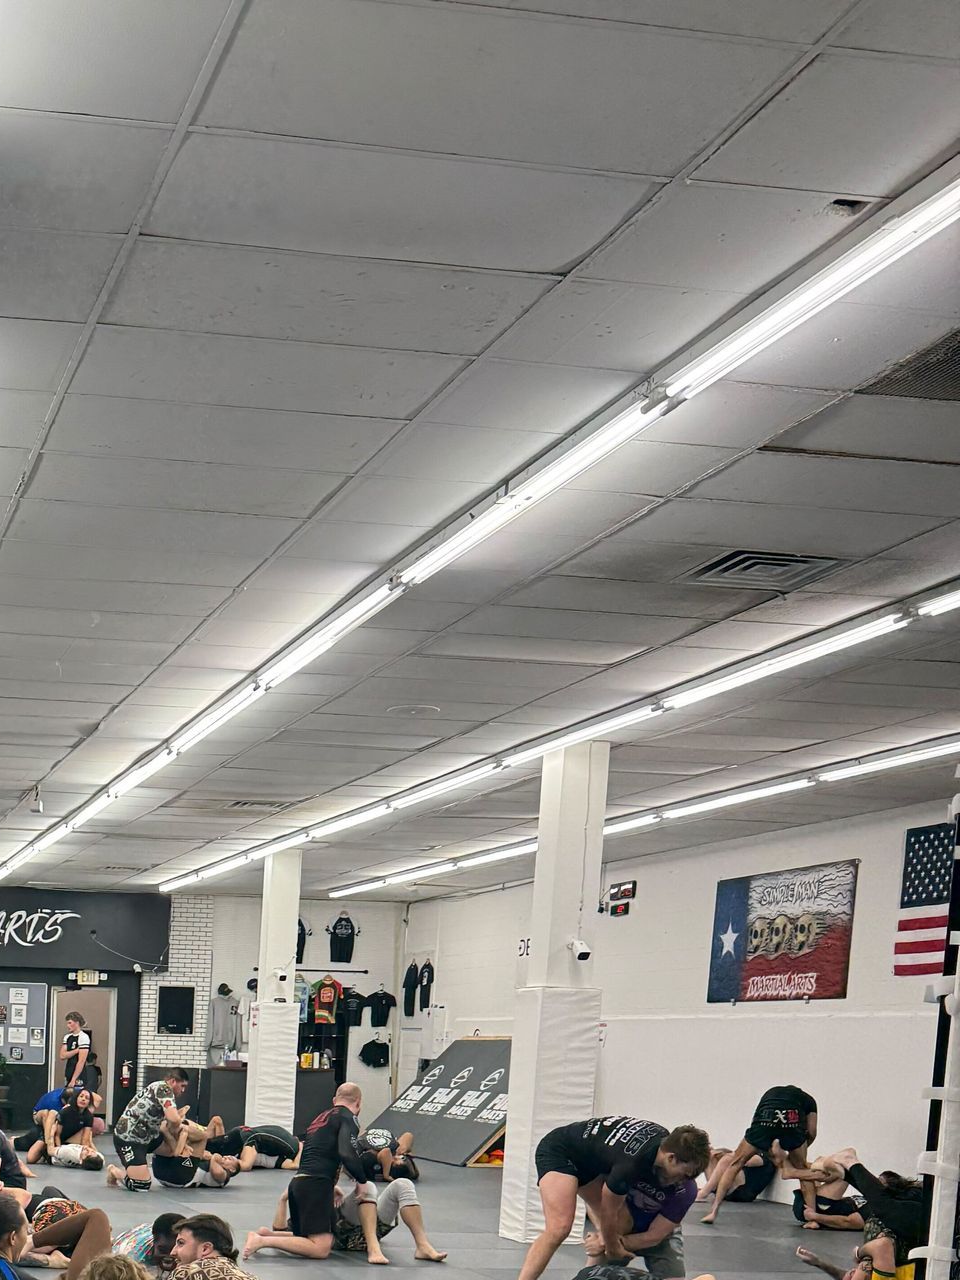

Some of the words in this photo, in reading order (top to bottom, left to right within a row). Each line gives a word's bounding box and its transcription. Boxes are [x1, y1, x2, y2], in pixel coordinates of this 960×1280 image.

[761, 884, 793, 905] SIMPLE
[793, 878, 819, 903] MAN
[745, 972, 790, 999] MARTIAL
[789, 971, 817, 994] ARTS
